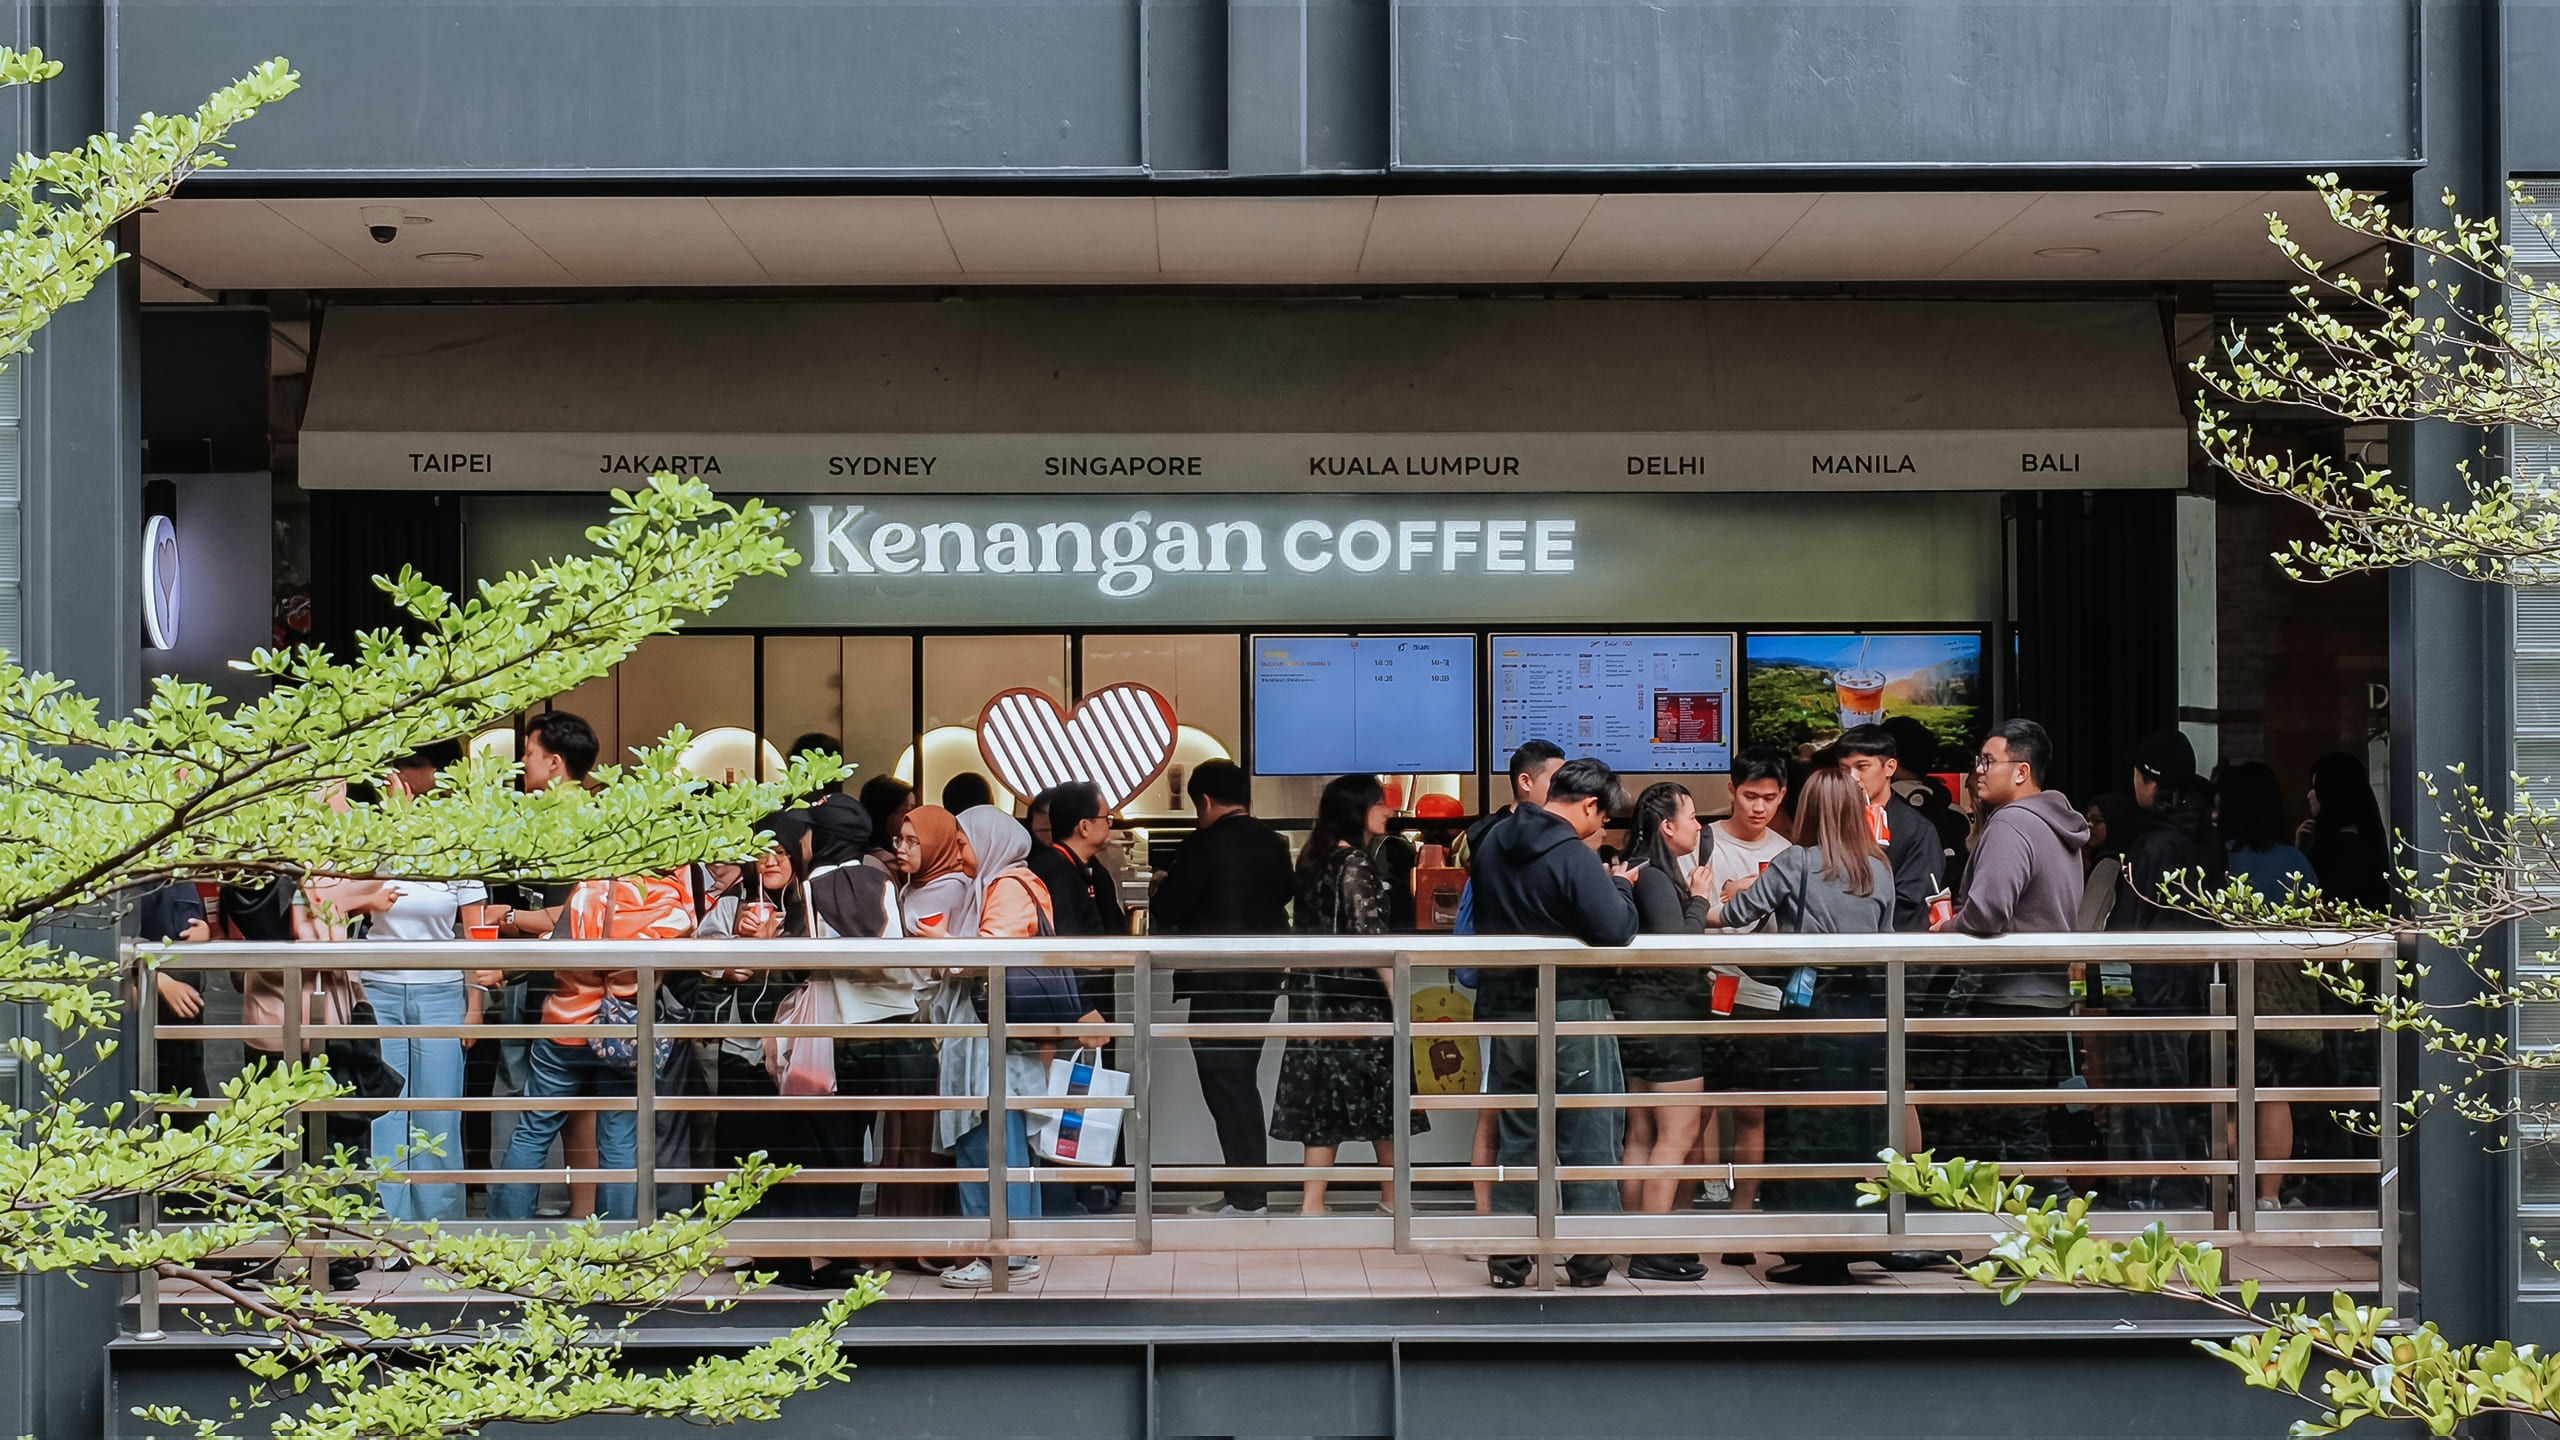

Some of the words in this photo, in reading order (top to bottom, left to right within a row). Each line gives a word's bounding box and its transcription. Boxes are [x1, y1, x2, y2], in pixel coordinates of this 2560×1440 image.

[408, 453, 492, 473] TAIPEI
[599, 454, 722, 475] JAKARTA
[828, 456, 937, 476] SYDNEY
[1044, 456, 1202, 476] SINGAPORE
[1309, 456, 1400, 476] KUALA
[1405, 456, 1520, 476] LUMPUR
[1627, 456, 1705, 476] DELHI
[1812, 454, 1916, 474] MANILA
[2021, 453, 2080, 473] BALI
[808, 505, 1267, 597] Kenangan
[1283, 519, 1576, 572] COFFEE
